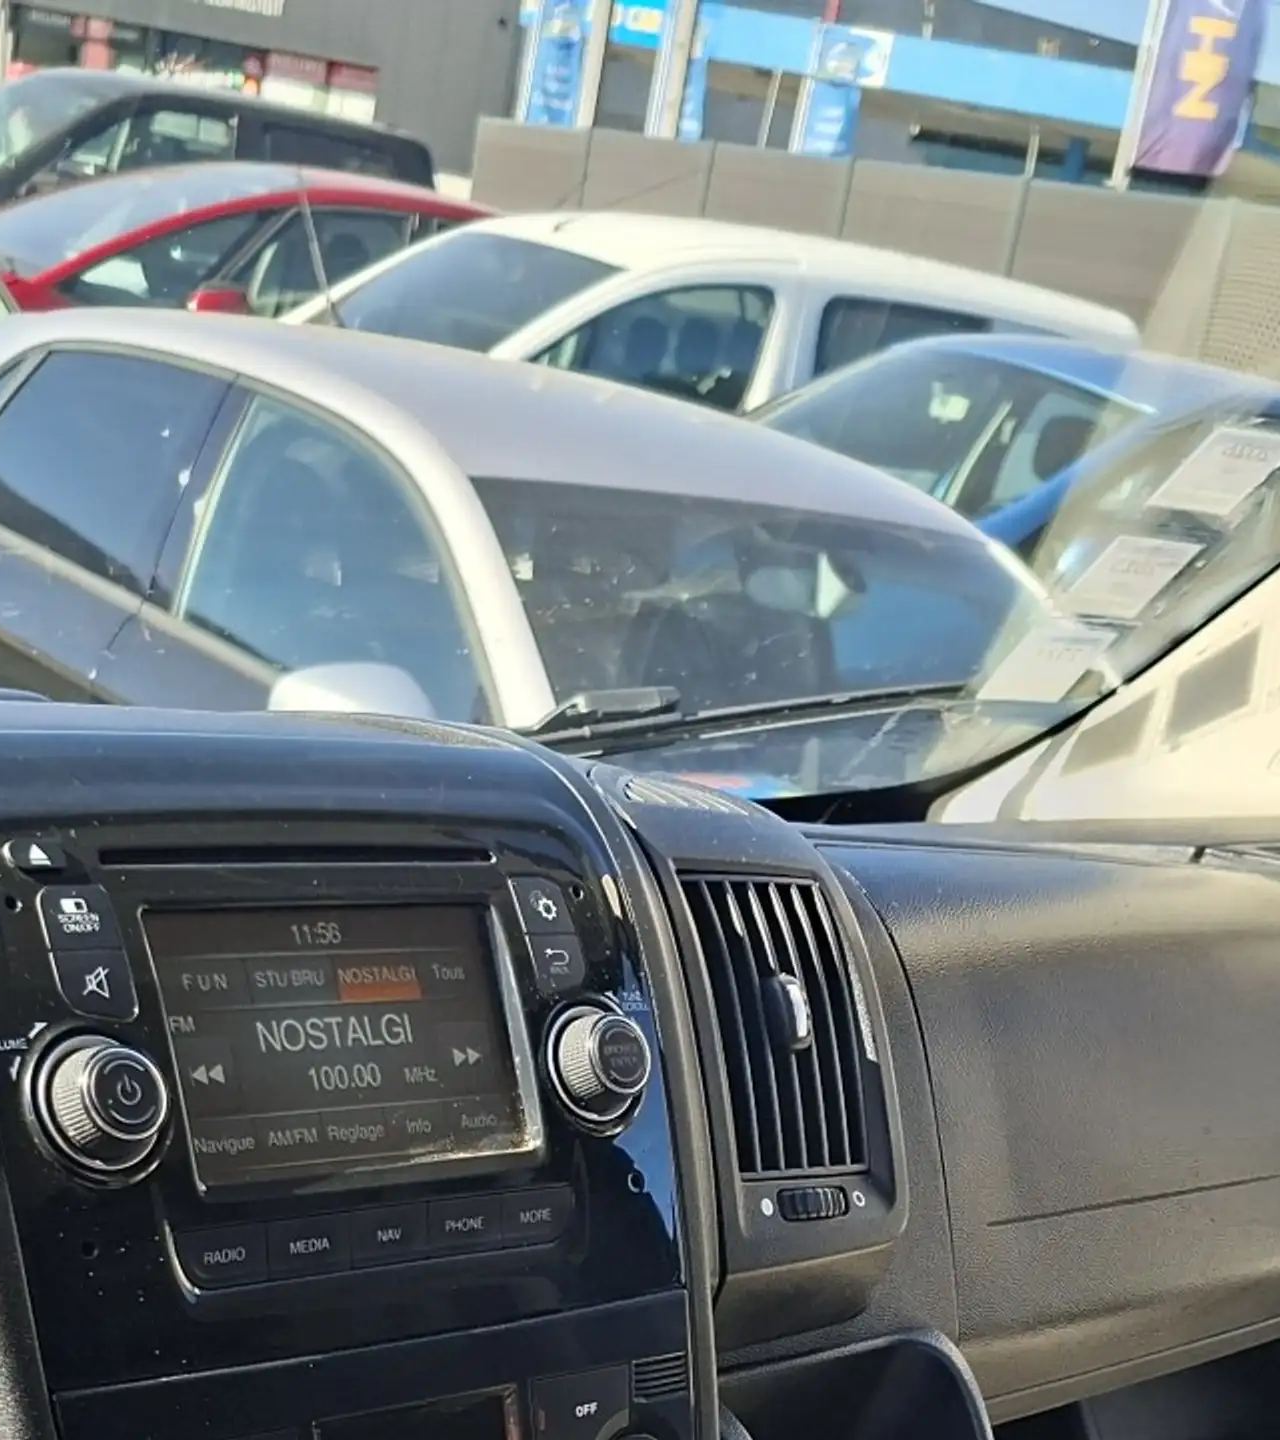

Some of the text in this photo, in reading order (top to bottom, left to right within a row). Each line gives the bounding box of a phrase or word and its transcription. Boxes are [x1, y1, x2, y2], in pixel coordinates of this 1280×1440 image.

[57, 912, 100, 924] SCREEN
[63, 922, 100, 933] ON/OFF
[290, 922, 341, 944] 11:56
[338, 965, 417, 984] NOSTALGI
[432, 963, 465, 980] Tous
[170, 1015, 195, 1034] FM
[256, 1012, 414, 1053] NOSTALGI
[308, 1063, 438, 1091] 100.00 MHz
[193, 1136, 255, 1156] Navigue
[268, 1127, 320, 1148] AM/FM
[406, 1117, 432, 1133] Info
[461, 1112, 498, 1129] Audio
[445, 1215, 485, 1234] PHONE
[520, 1207, 552, 1224] MORE
[377, 1227, 403, 1243] NAV
[289, 1236, 330, 1255] MEDIA
[203, 1246, 246, 1265] RADIO
[575, 1402, 598, 1418] OFF
